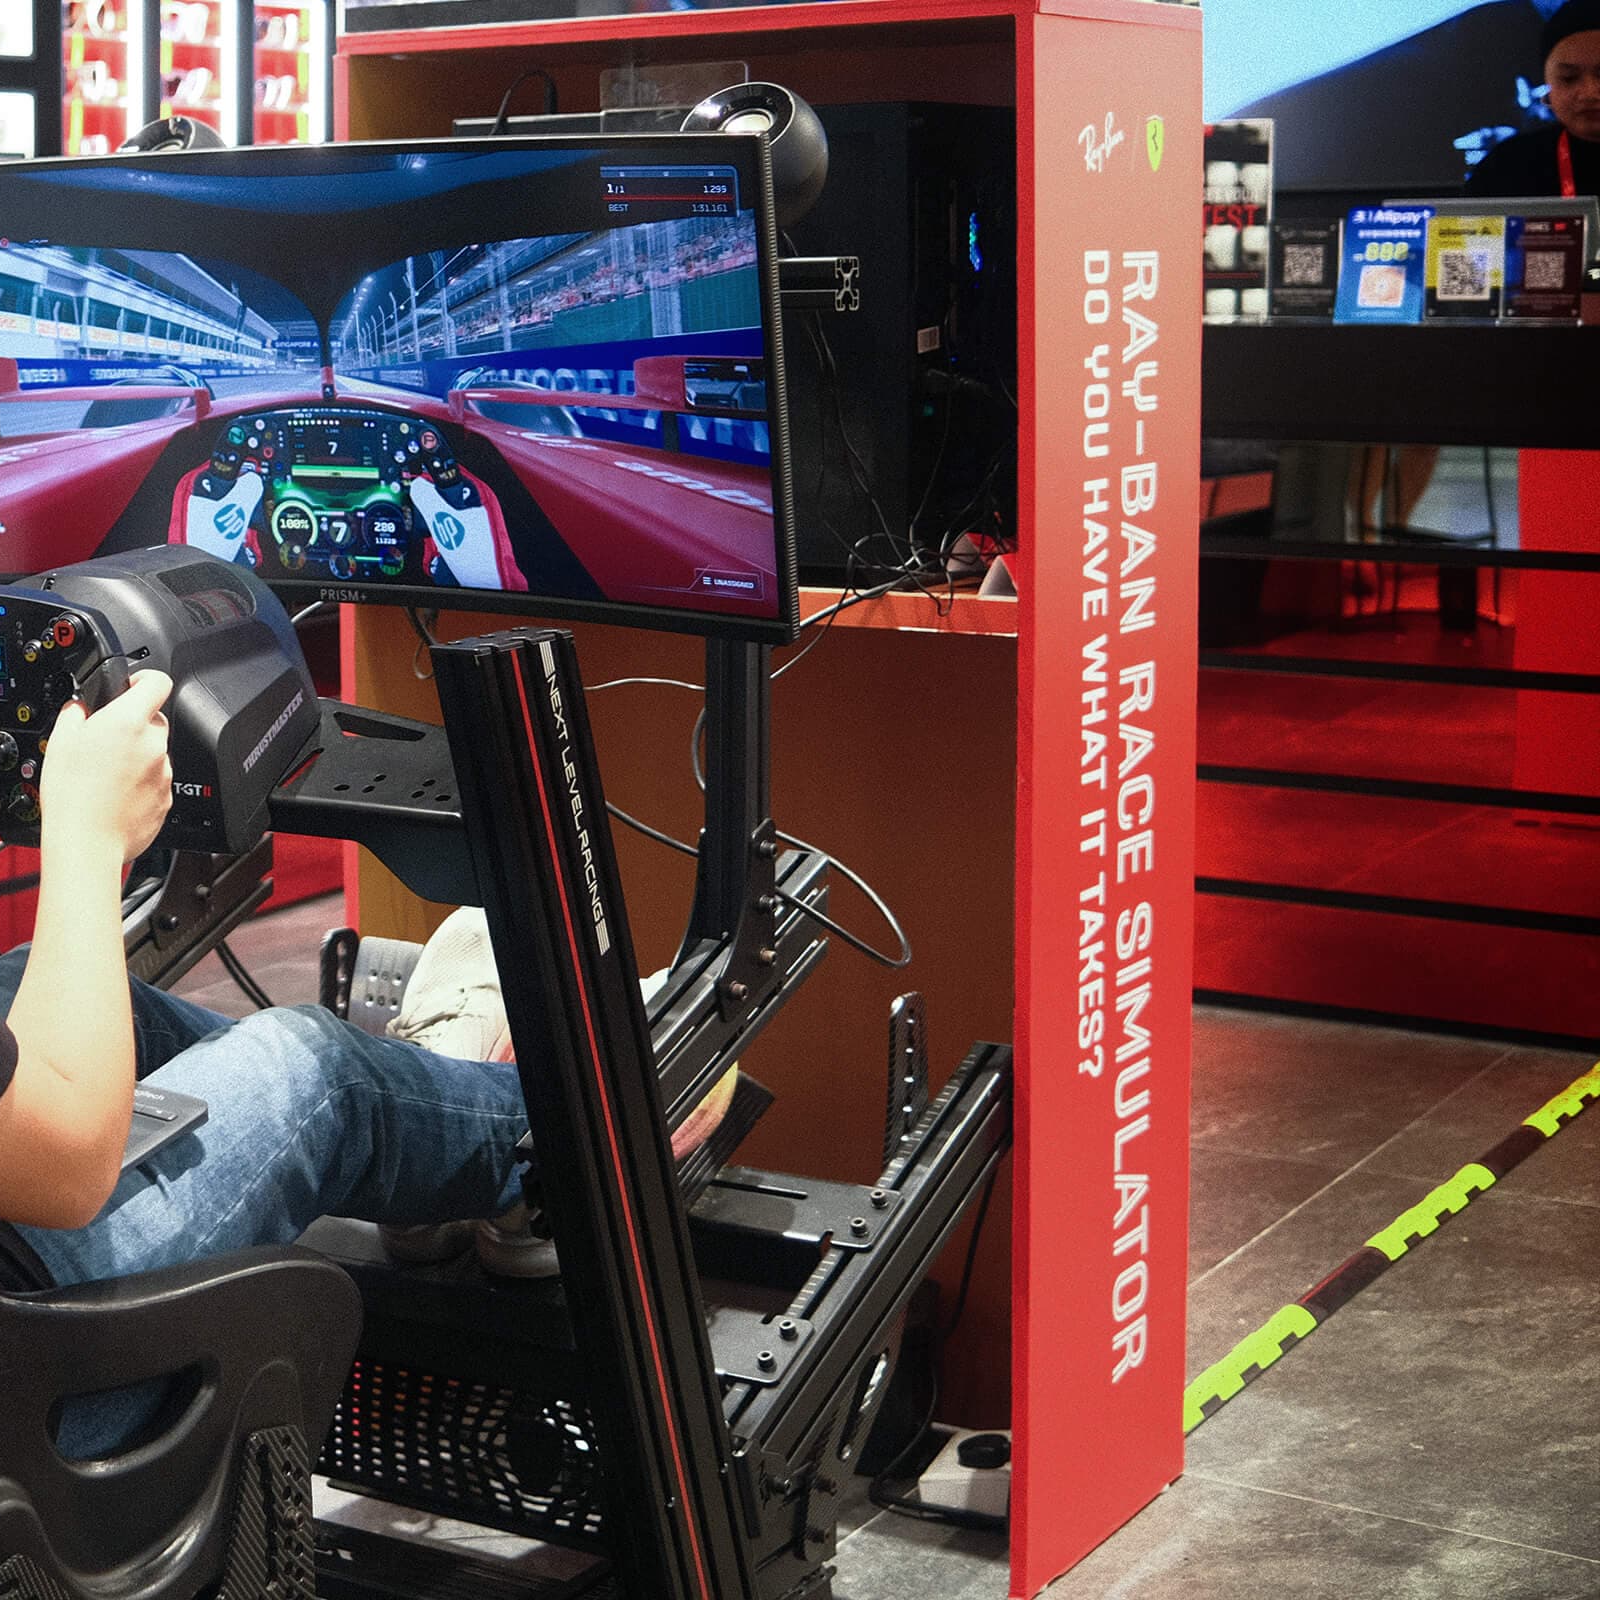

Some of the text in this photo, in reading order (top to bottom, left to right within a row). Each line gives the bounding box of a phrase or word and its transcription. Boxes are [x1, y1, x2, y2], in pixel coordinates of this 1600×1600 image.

[608, 203, 629, 212] BEST
[328, 441, 338, 455] 7
[331, 521, 348, 543] 7
[320, 588, 368, 602] PRISM+
[57, 626, 71, 642] P
[1078, 250, 1110, 1078] DO YOU HAVE WHAT IT TAKES?
[242, 688, 304, 774] THRUSTMASTER
[547, 673, 605, 924] NEXT LEVEL RACING
[1111, 250, 1160, 1384] RAY-BAN RACE SIMULATOR
